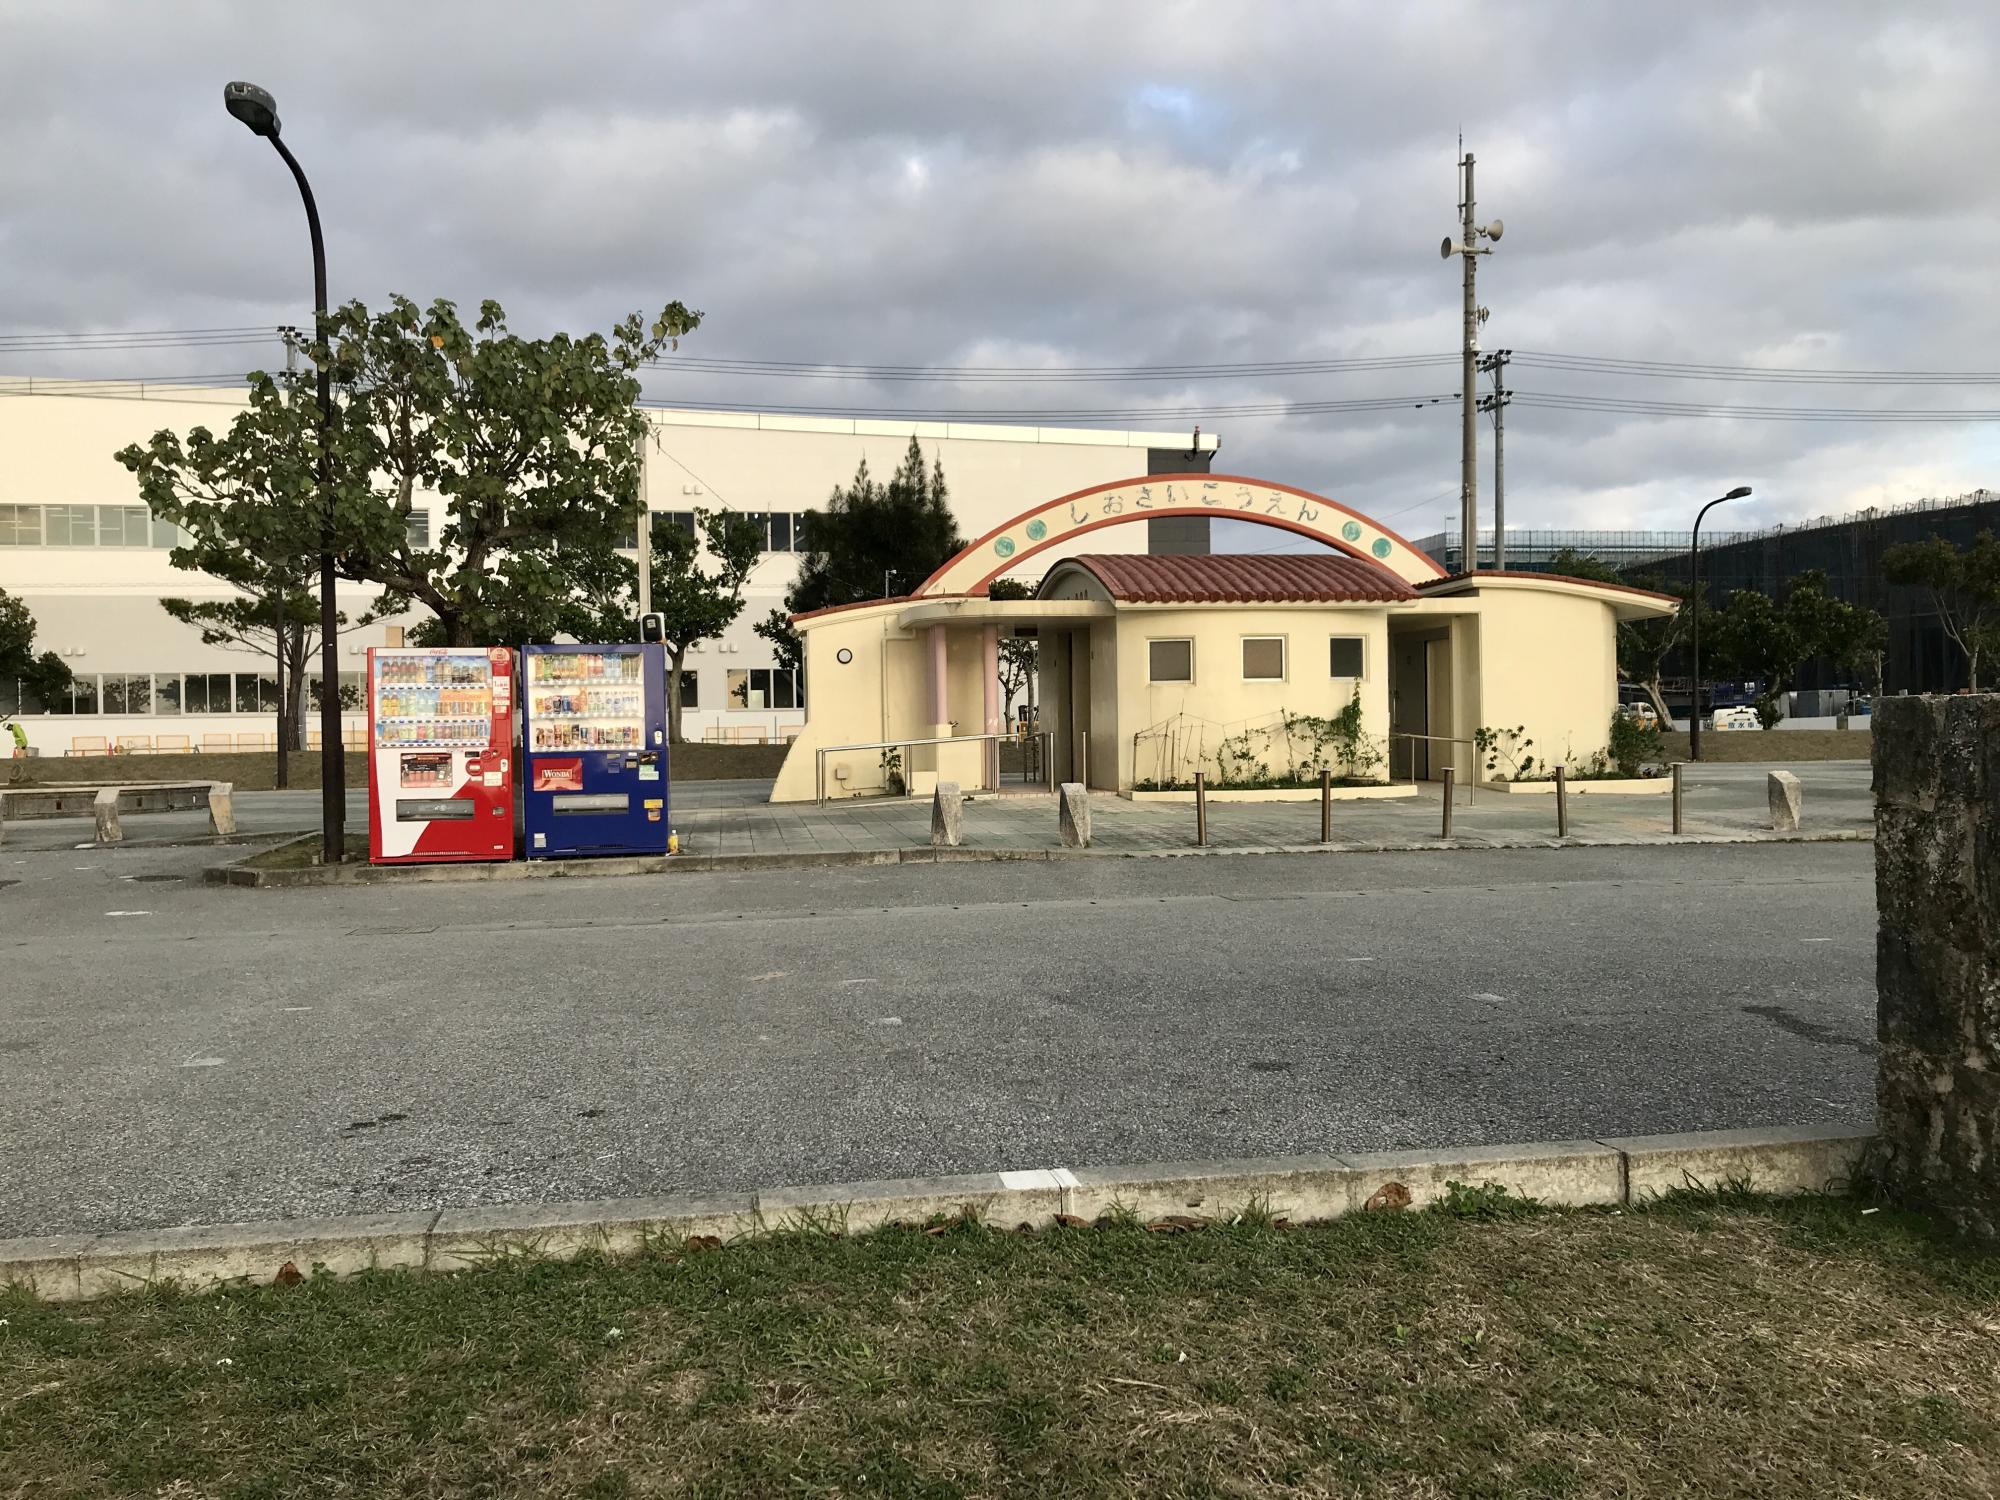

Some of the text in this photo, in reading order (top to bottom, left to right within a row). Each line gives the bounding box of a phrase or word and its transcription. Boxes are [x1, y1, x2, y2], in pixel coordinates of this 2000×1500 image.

[1070, 483, 1318, 524] しおさいこうえん
[1728, 721, 1755, 729] 散水車
[543, 769, 570, 778] WONDA
